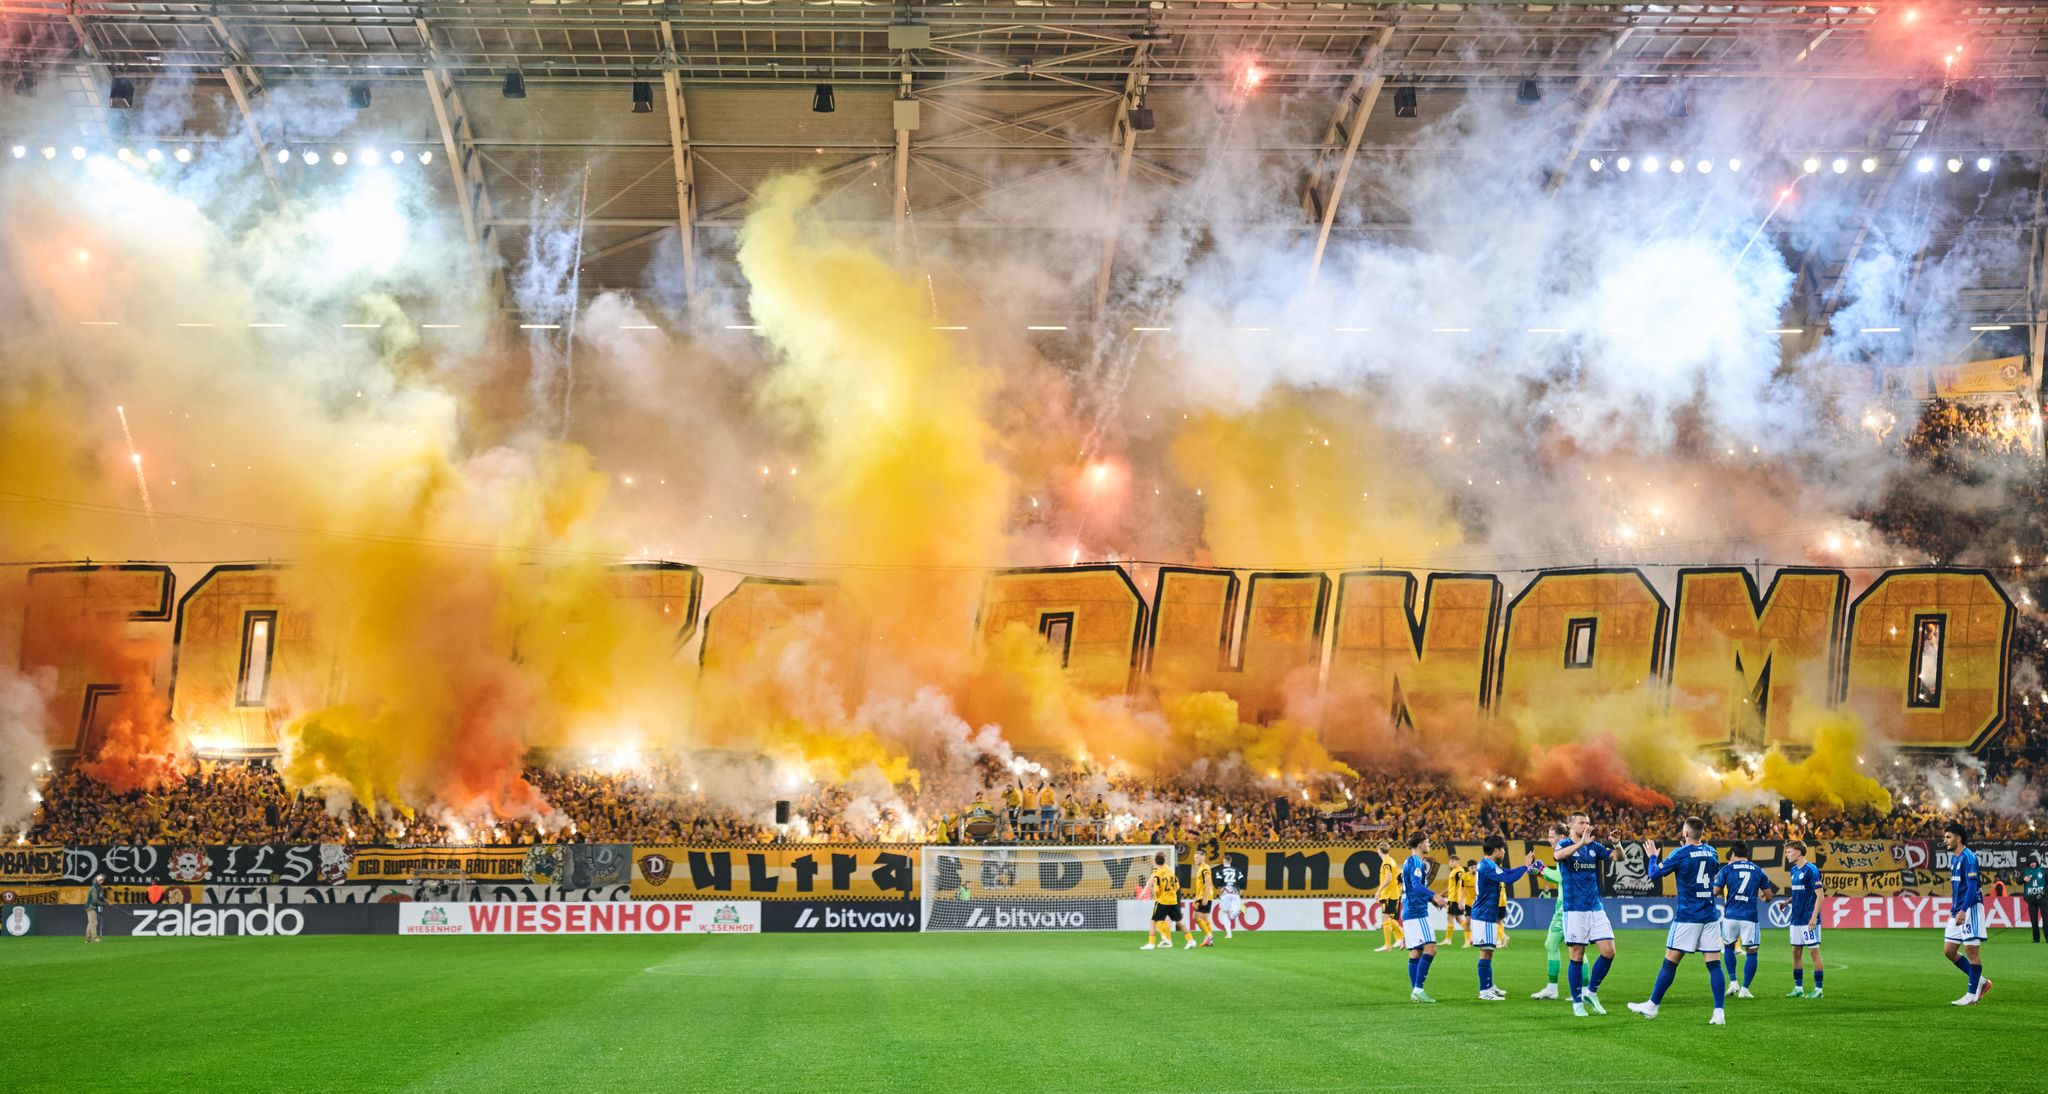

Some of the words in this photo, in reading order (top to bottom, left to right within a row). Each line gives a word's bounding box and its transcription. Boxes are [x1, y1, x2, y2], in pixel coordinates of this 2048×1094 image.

[980, 563, 2017, 757] DYNAMO
[1162, 877, 1175, 892] 24
[1223, 871, 1237, 883] 22
[1696, 861, 1710, 889] 4
[1738, 871, 1751, 894] 7
[132, 904, 304, 936] zalando
[468, 904, 693, 932] WIESENHOF
[825, 908, 915, 929] bitvavo
[996, 908, 1084, 928] bitvavo
[1804, 930, 1815, 941] 38
